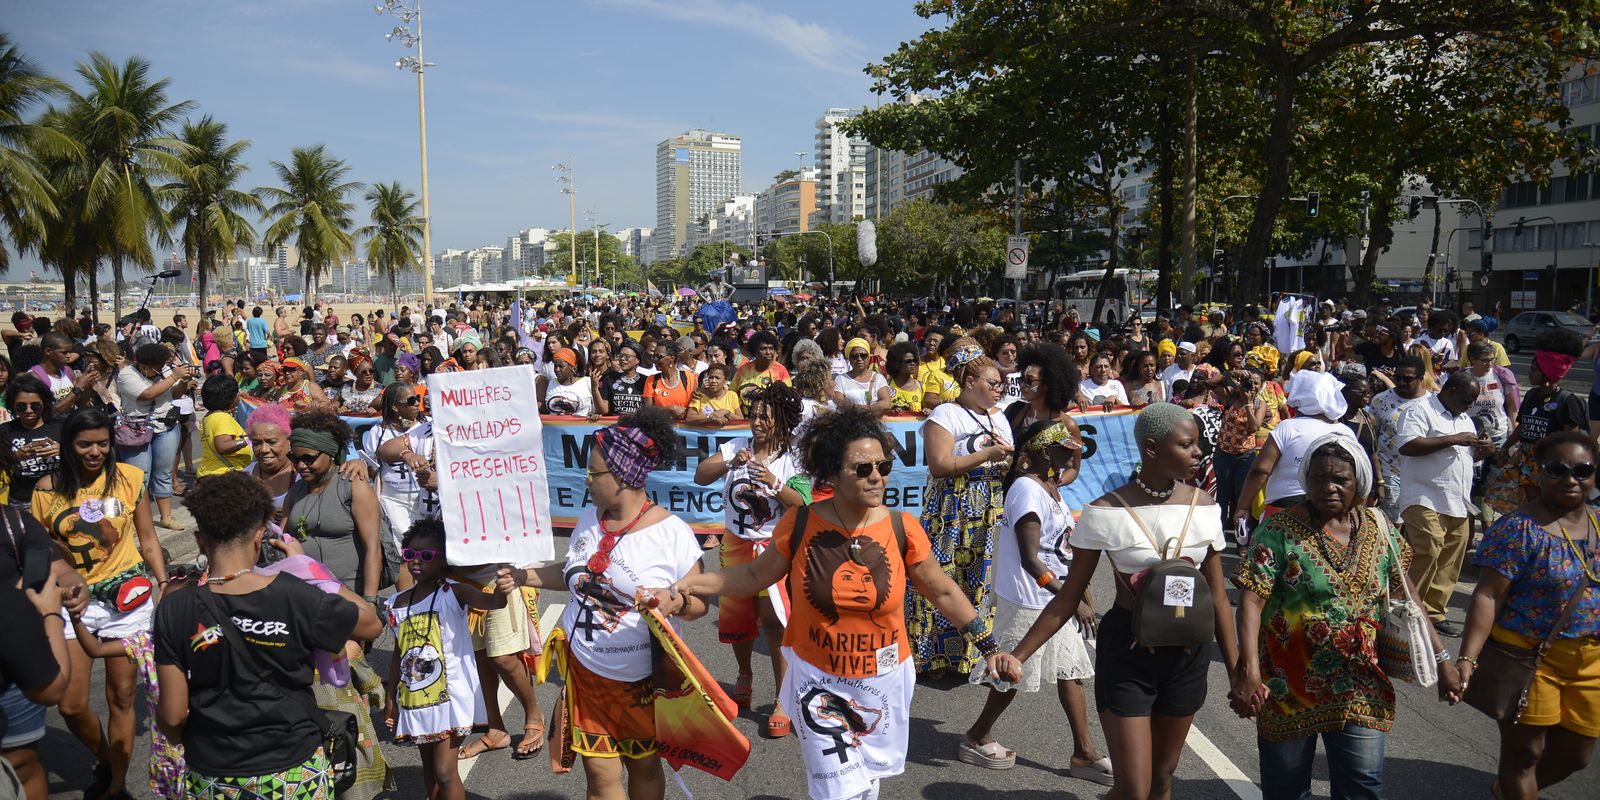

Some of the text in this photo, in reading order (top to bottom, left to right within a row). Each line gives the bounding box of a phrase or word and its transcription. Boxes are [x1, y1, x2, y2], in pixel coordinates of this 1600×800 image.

[441, 386, 512, 408] MULHERES
[445, 418, 522, 443] FAVELADAS
[450, 455, 538, 480] PRESENTES
[557, 488, 574, 507] E
[610, 554, 640, 583] ulheres
[808, 625, 899, 653] MARIELLE
[820, 676, 833, 685] de
[837, 677, 881, 696] Mulheres
